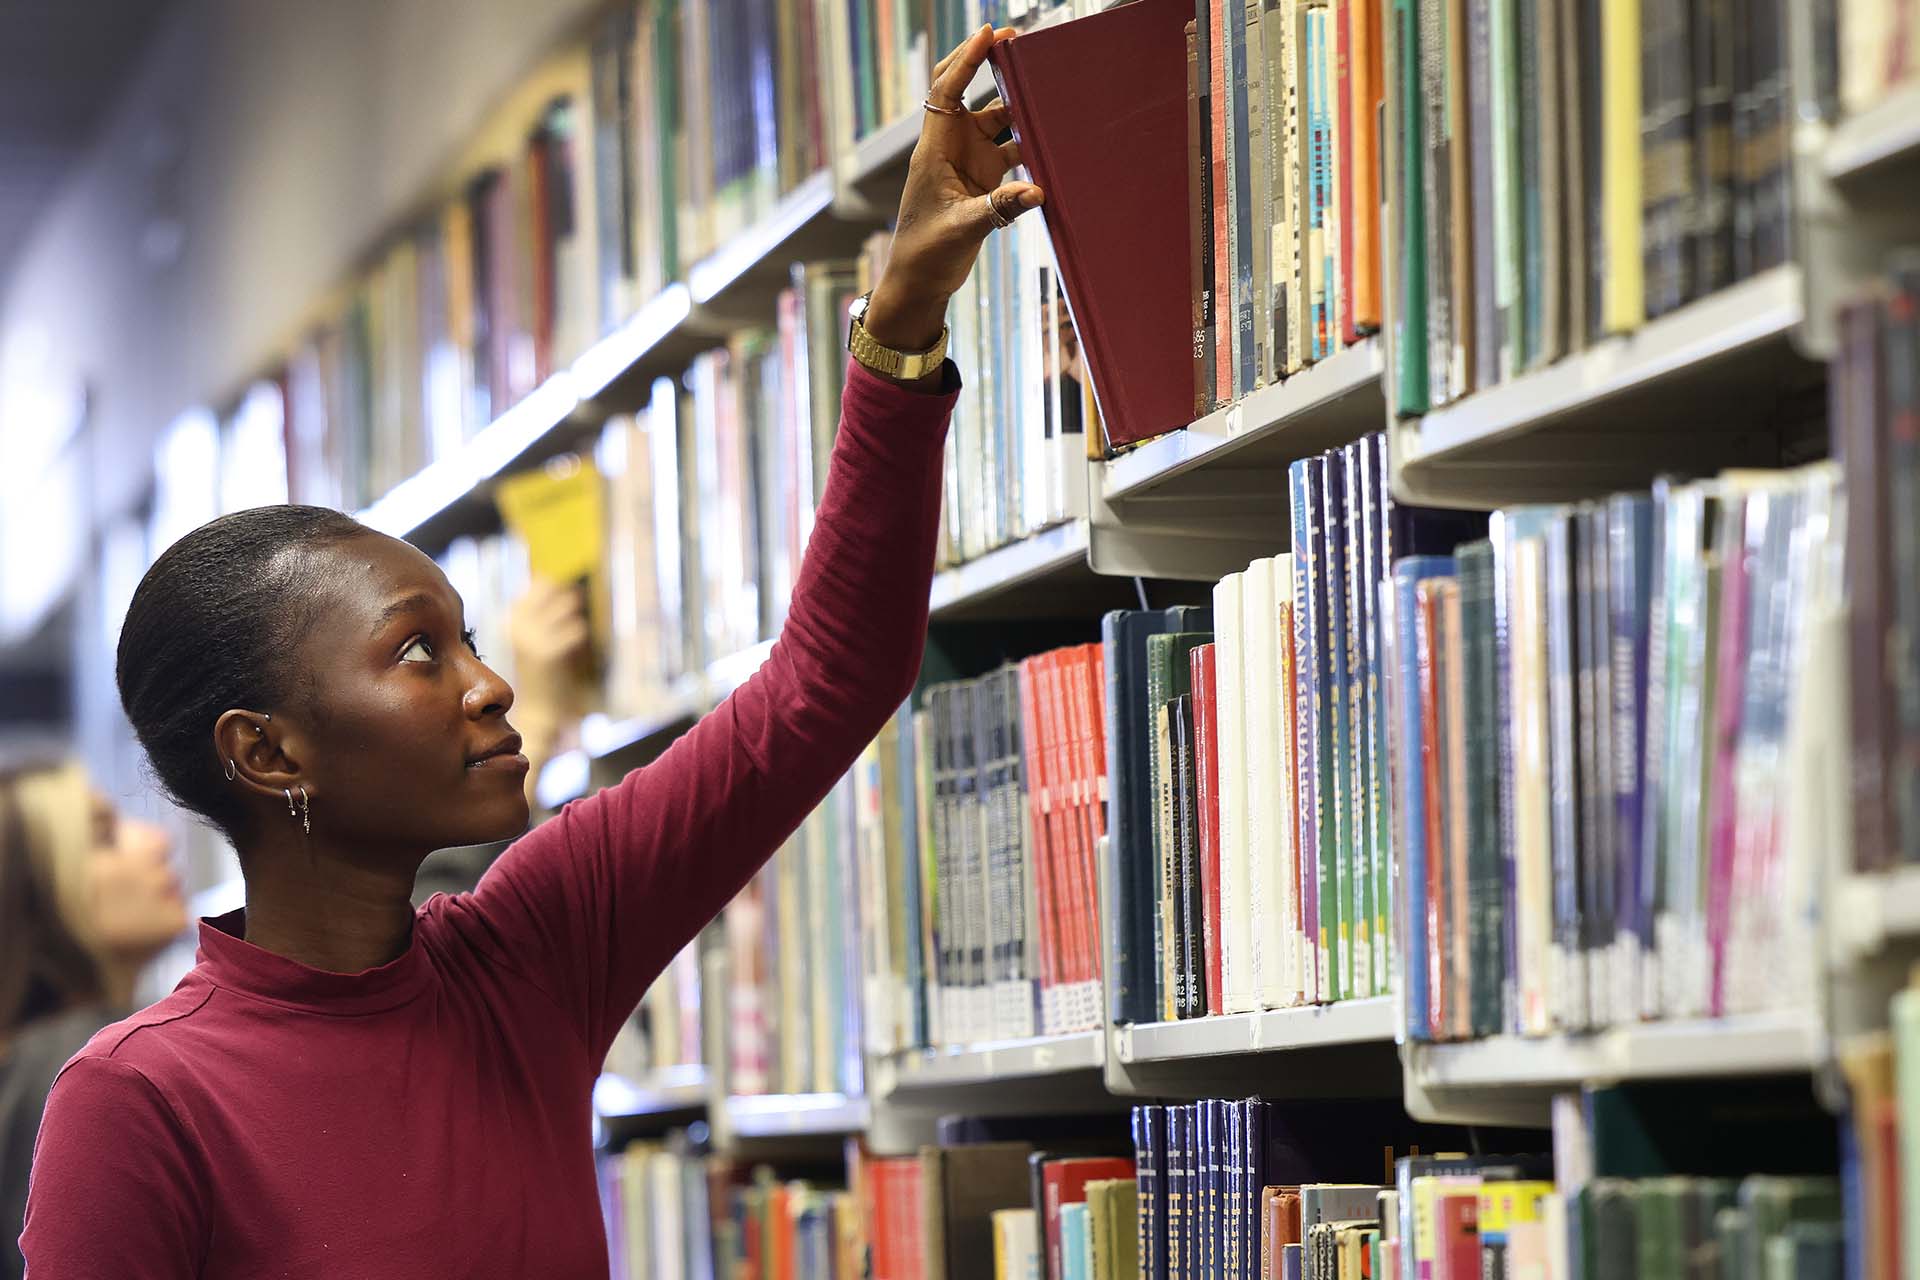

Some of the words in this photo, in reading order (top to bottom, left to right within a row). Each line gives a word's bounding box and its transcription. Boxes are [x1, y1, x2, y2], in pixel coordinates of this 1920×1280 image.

[1295, 568, 1307, 674] HUMAN
[1170, 744, 1178, 790] MALES
[1296, 681, 1310, 822] SEXUALITY
[1172, 794, 1180, 822] AND
